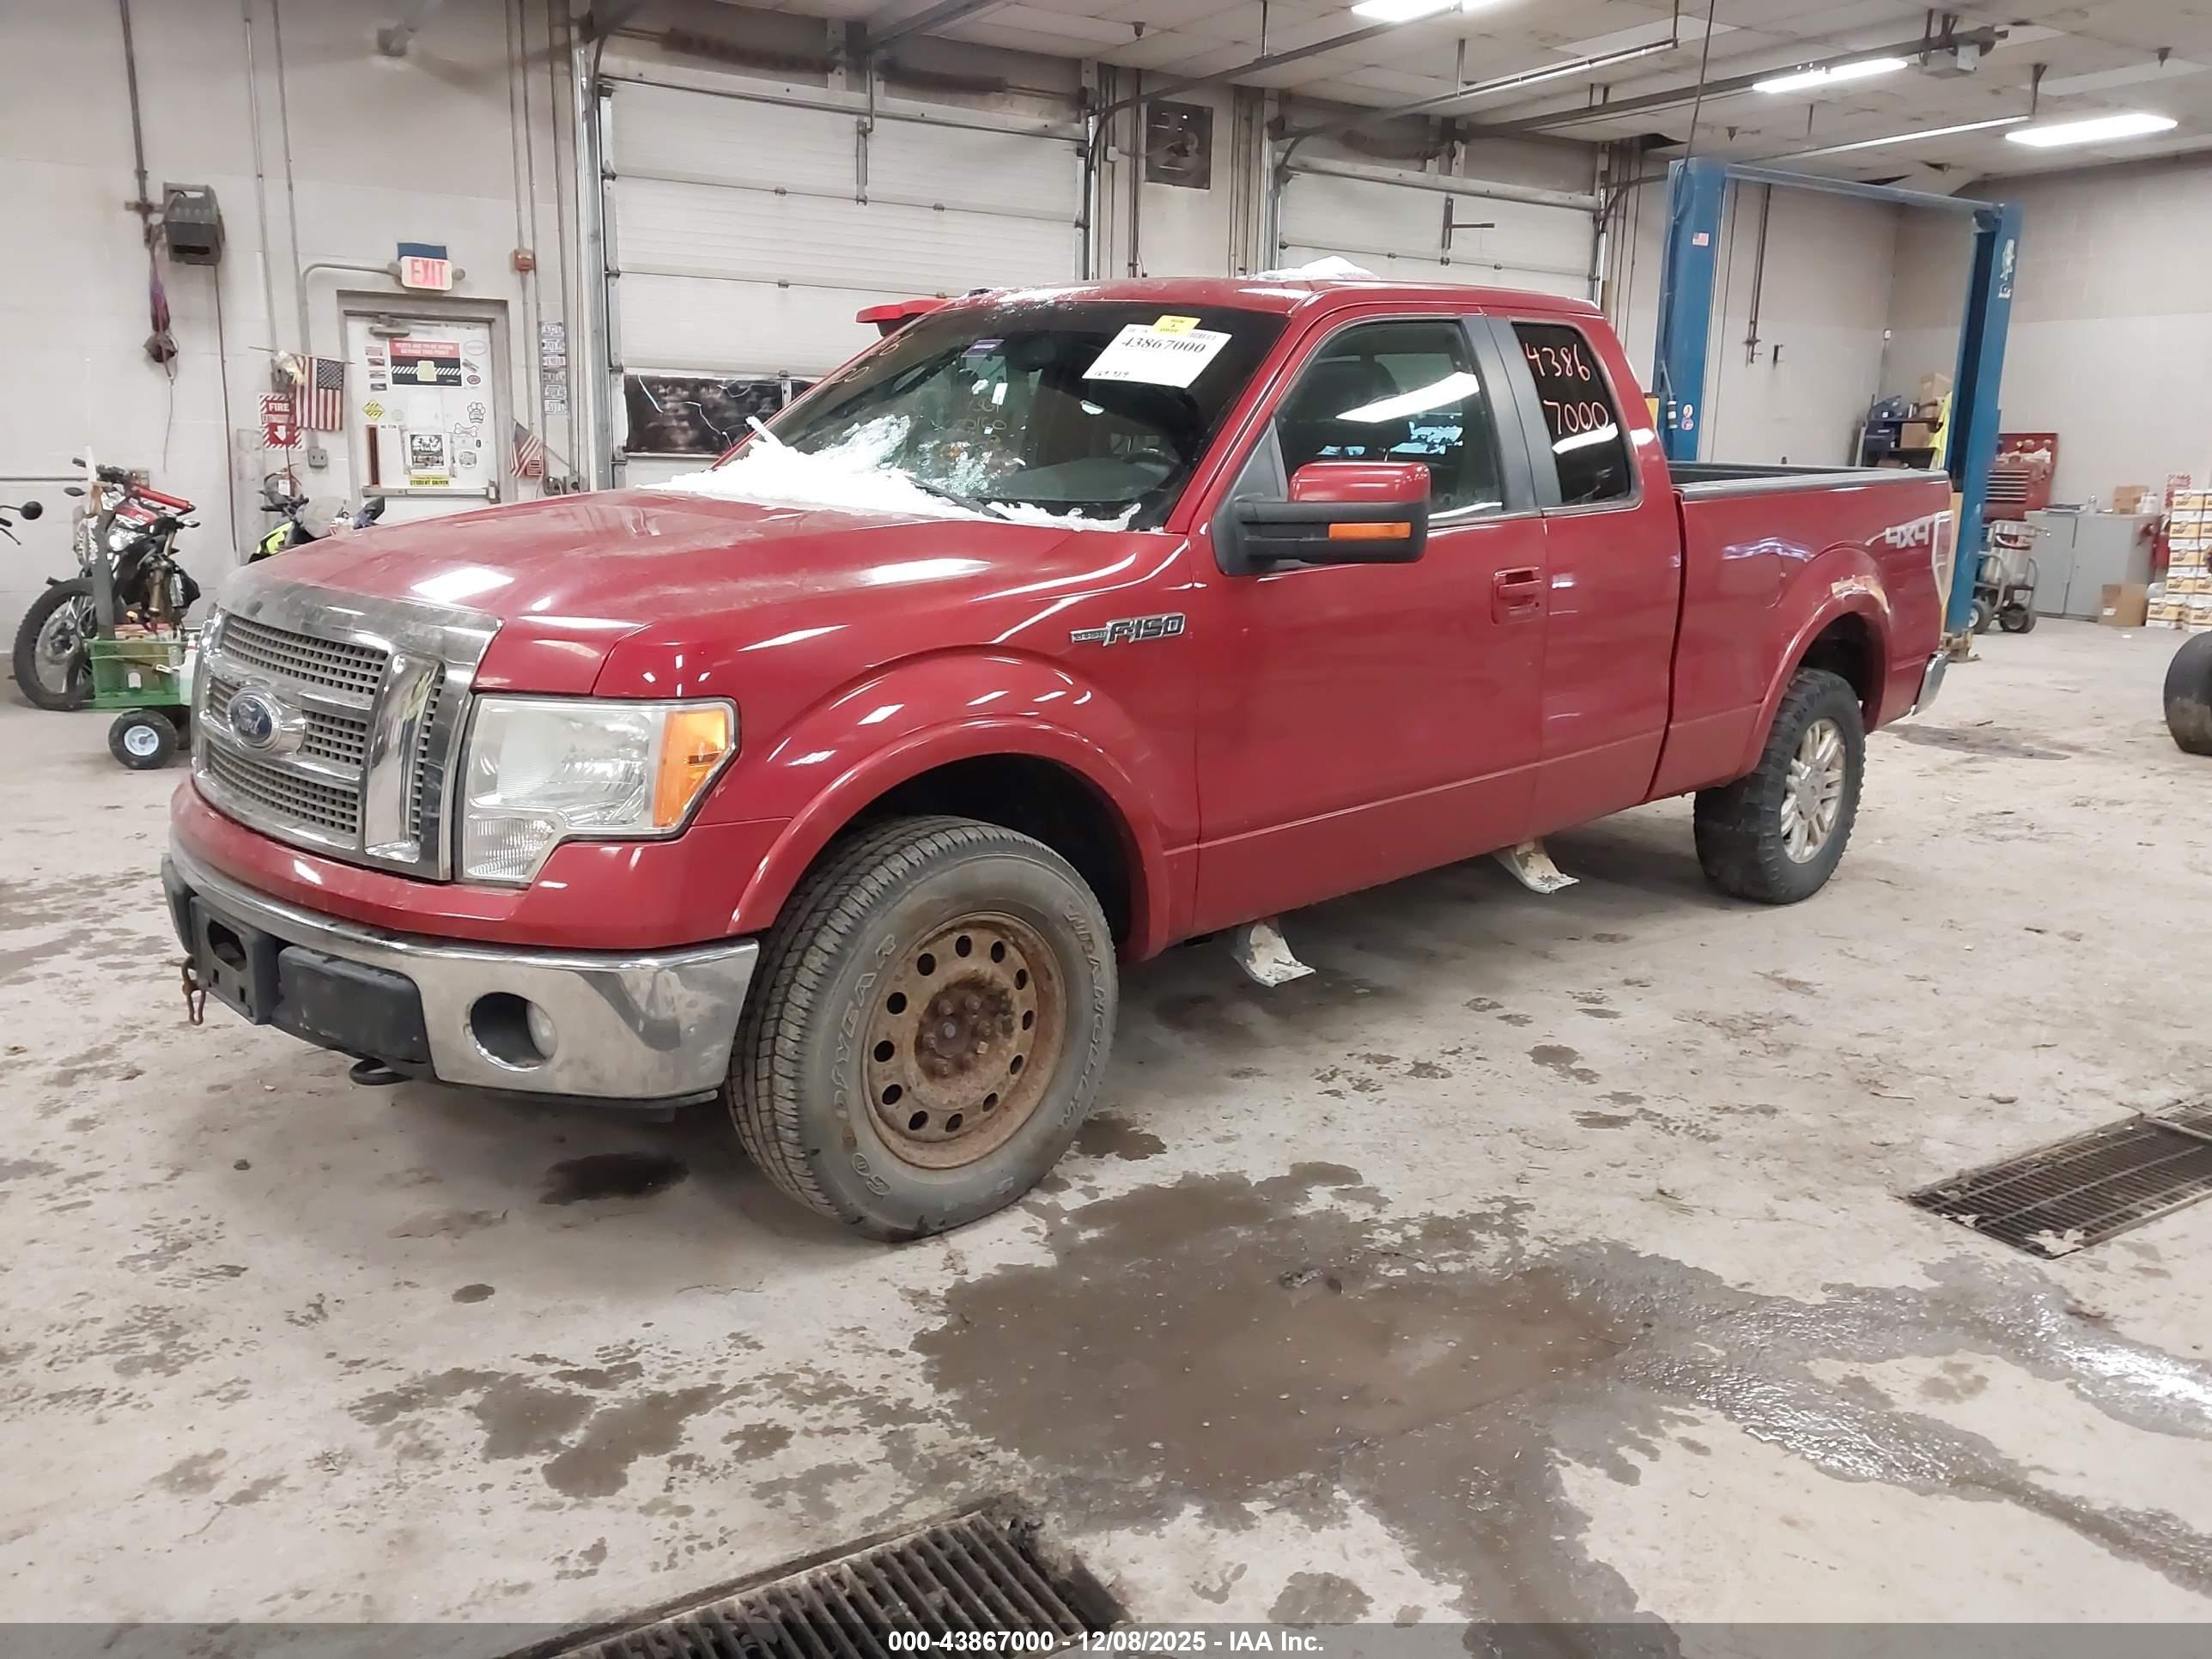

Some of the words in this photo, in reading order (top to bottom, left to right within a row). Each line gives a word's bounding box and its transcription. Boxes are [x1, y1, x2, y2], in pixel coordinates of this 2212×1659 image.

[410, 258, 446, 288] EXIT
[1121, 337, 1206, 354] 43867000
[1525, 343, 1591, 382] 4386
[268, 402, 289, 412] FIRE
[1542, 399, 1609, 435] 7000
[238, 702, 262, 735] Ford
